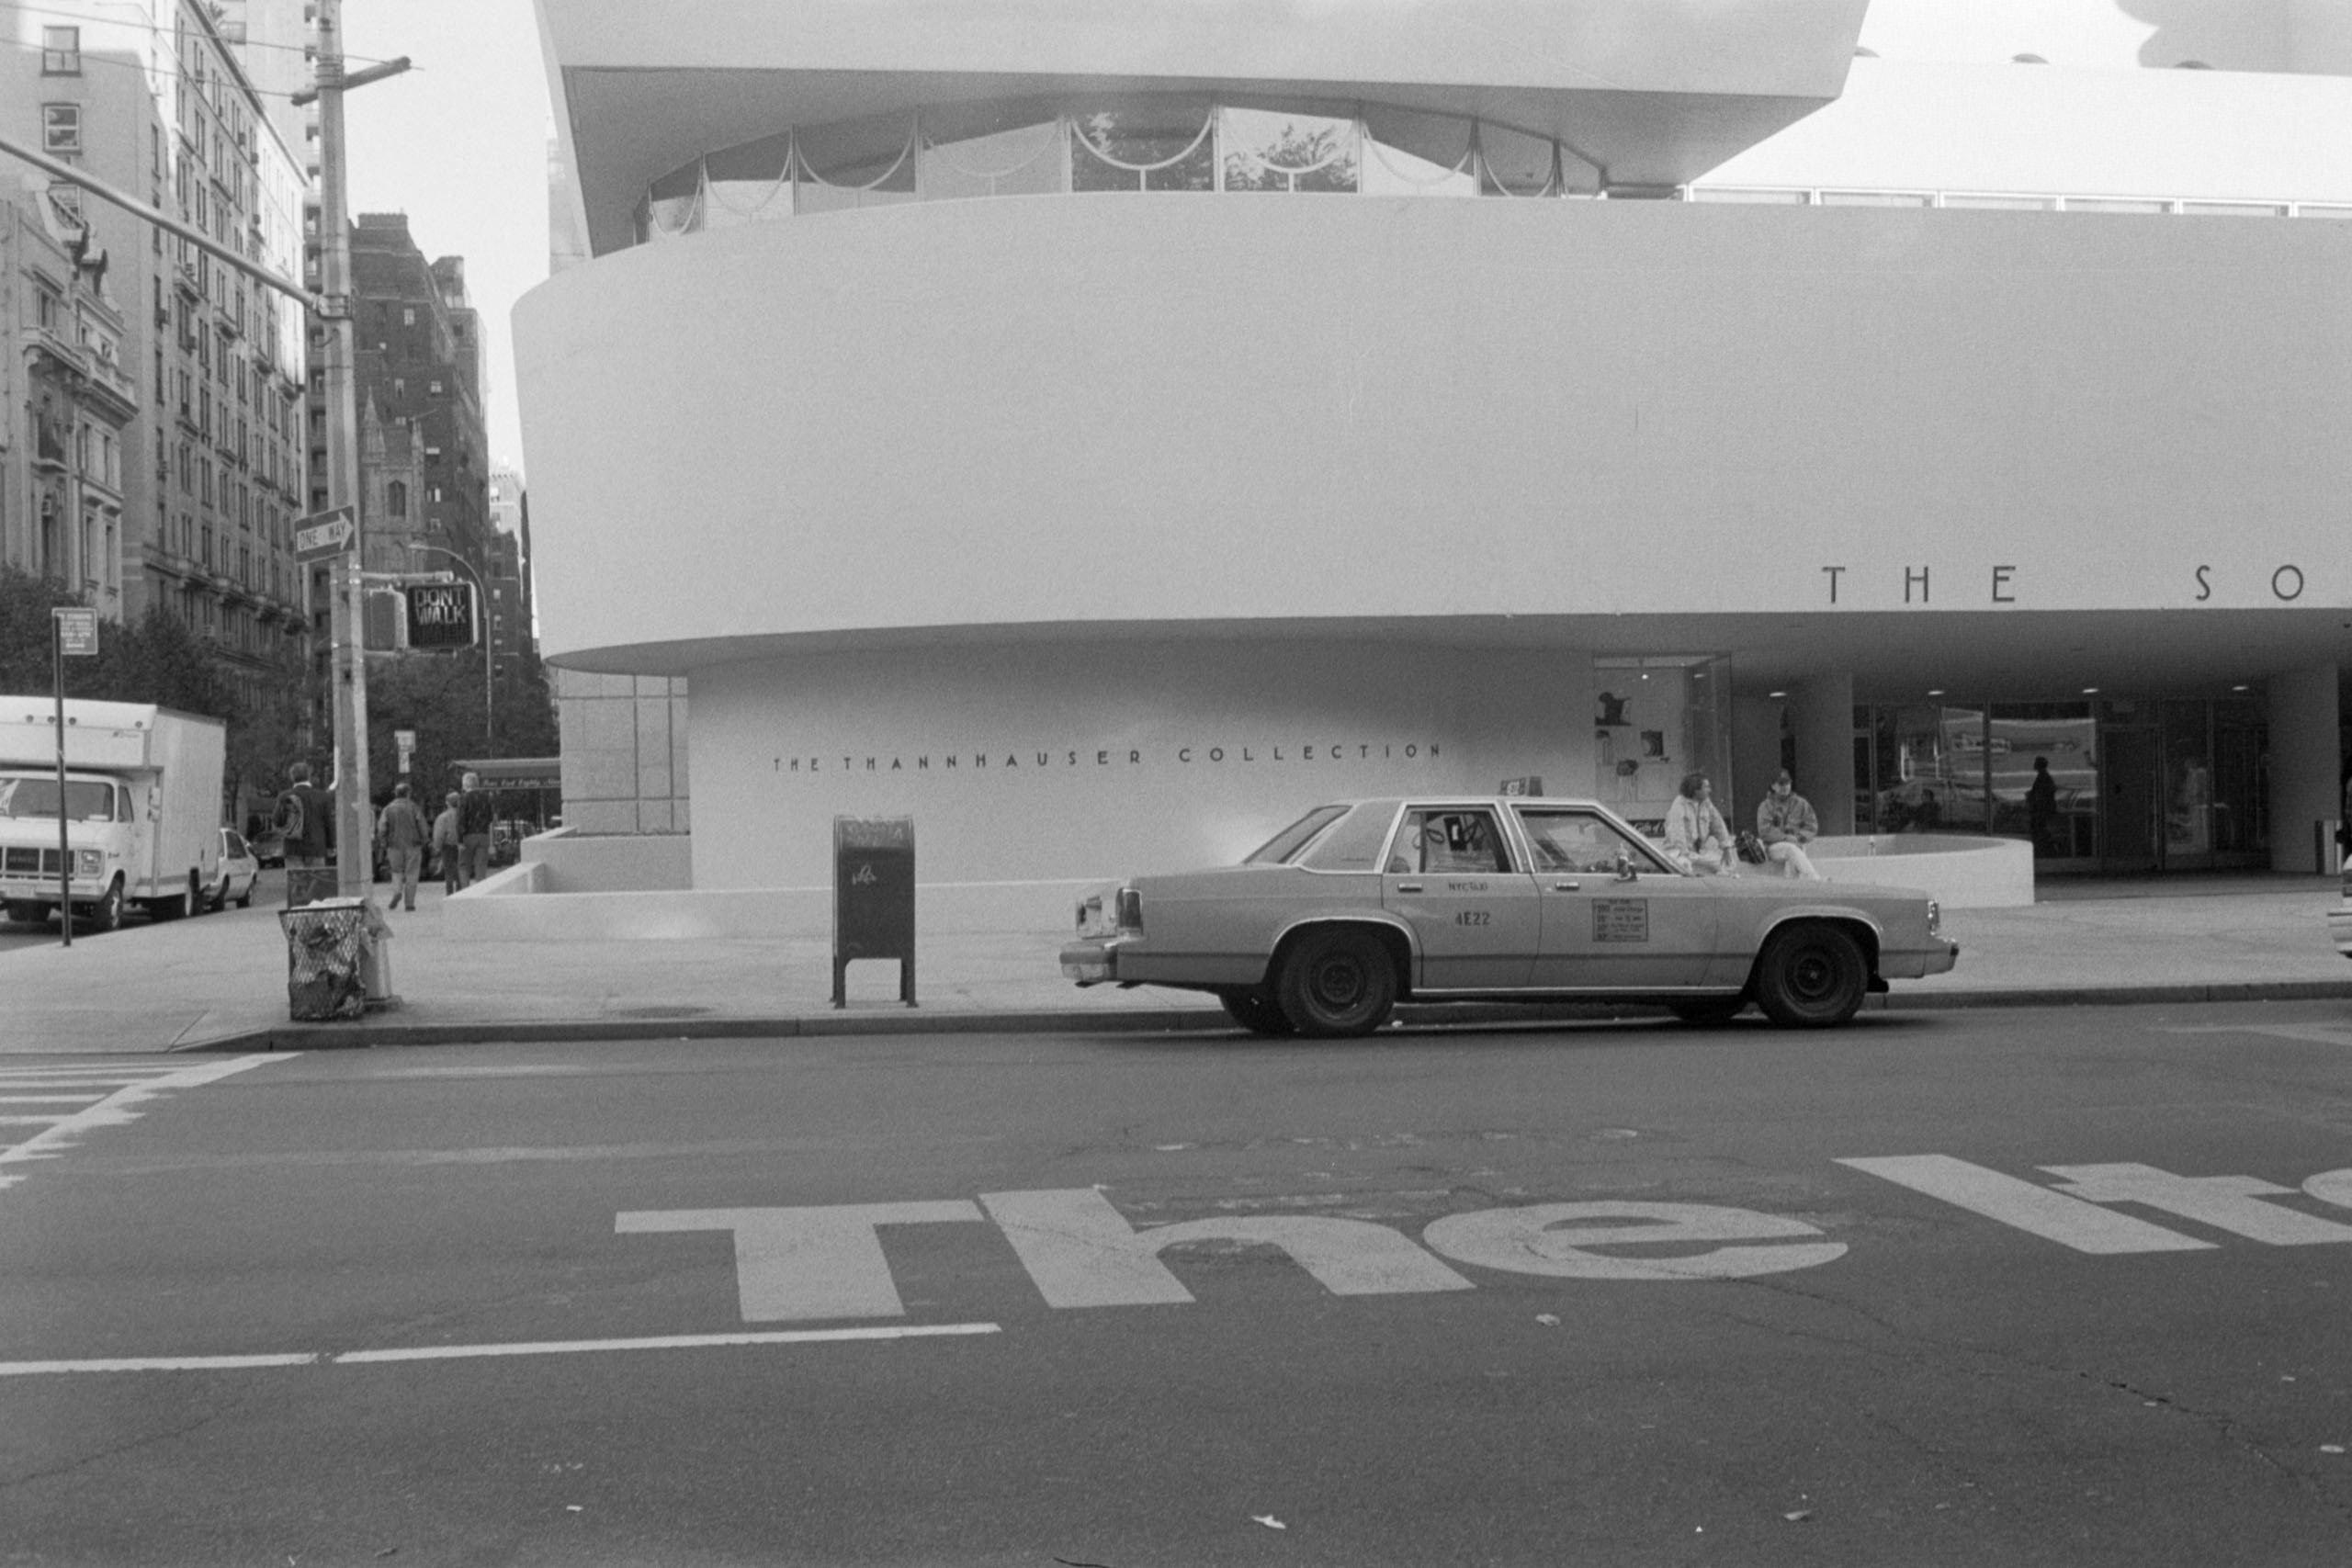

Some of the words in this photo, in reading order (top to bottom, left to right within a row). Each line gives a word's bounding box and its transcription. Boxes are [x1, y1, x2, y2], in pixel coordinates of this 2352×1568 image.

[300, 529, 318, 549] ONE
[328, 521, 346, 542] WAY
[1822, 566, 2016, 604] THE
[415, 606, 467, 625] WALK
[775, 758, 818, 772] THE
[844, 750, 1139, 770] THANNHAUSER
[1179, 743, 1439, 762] COLLECTION
